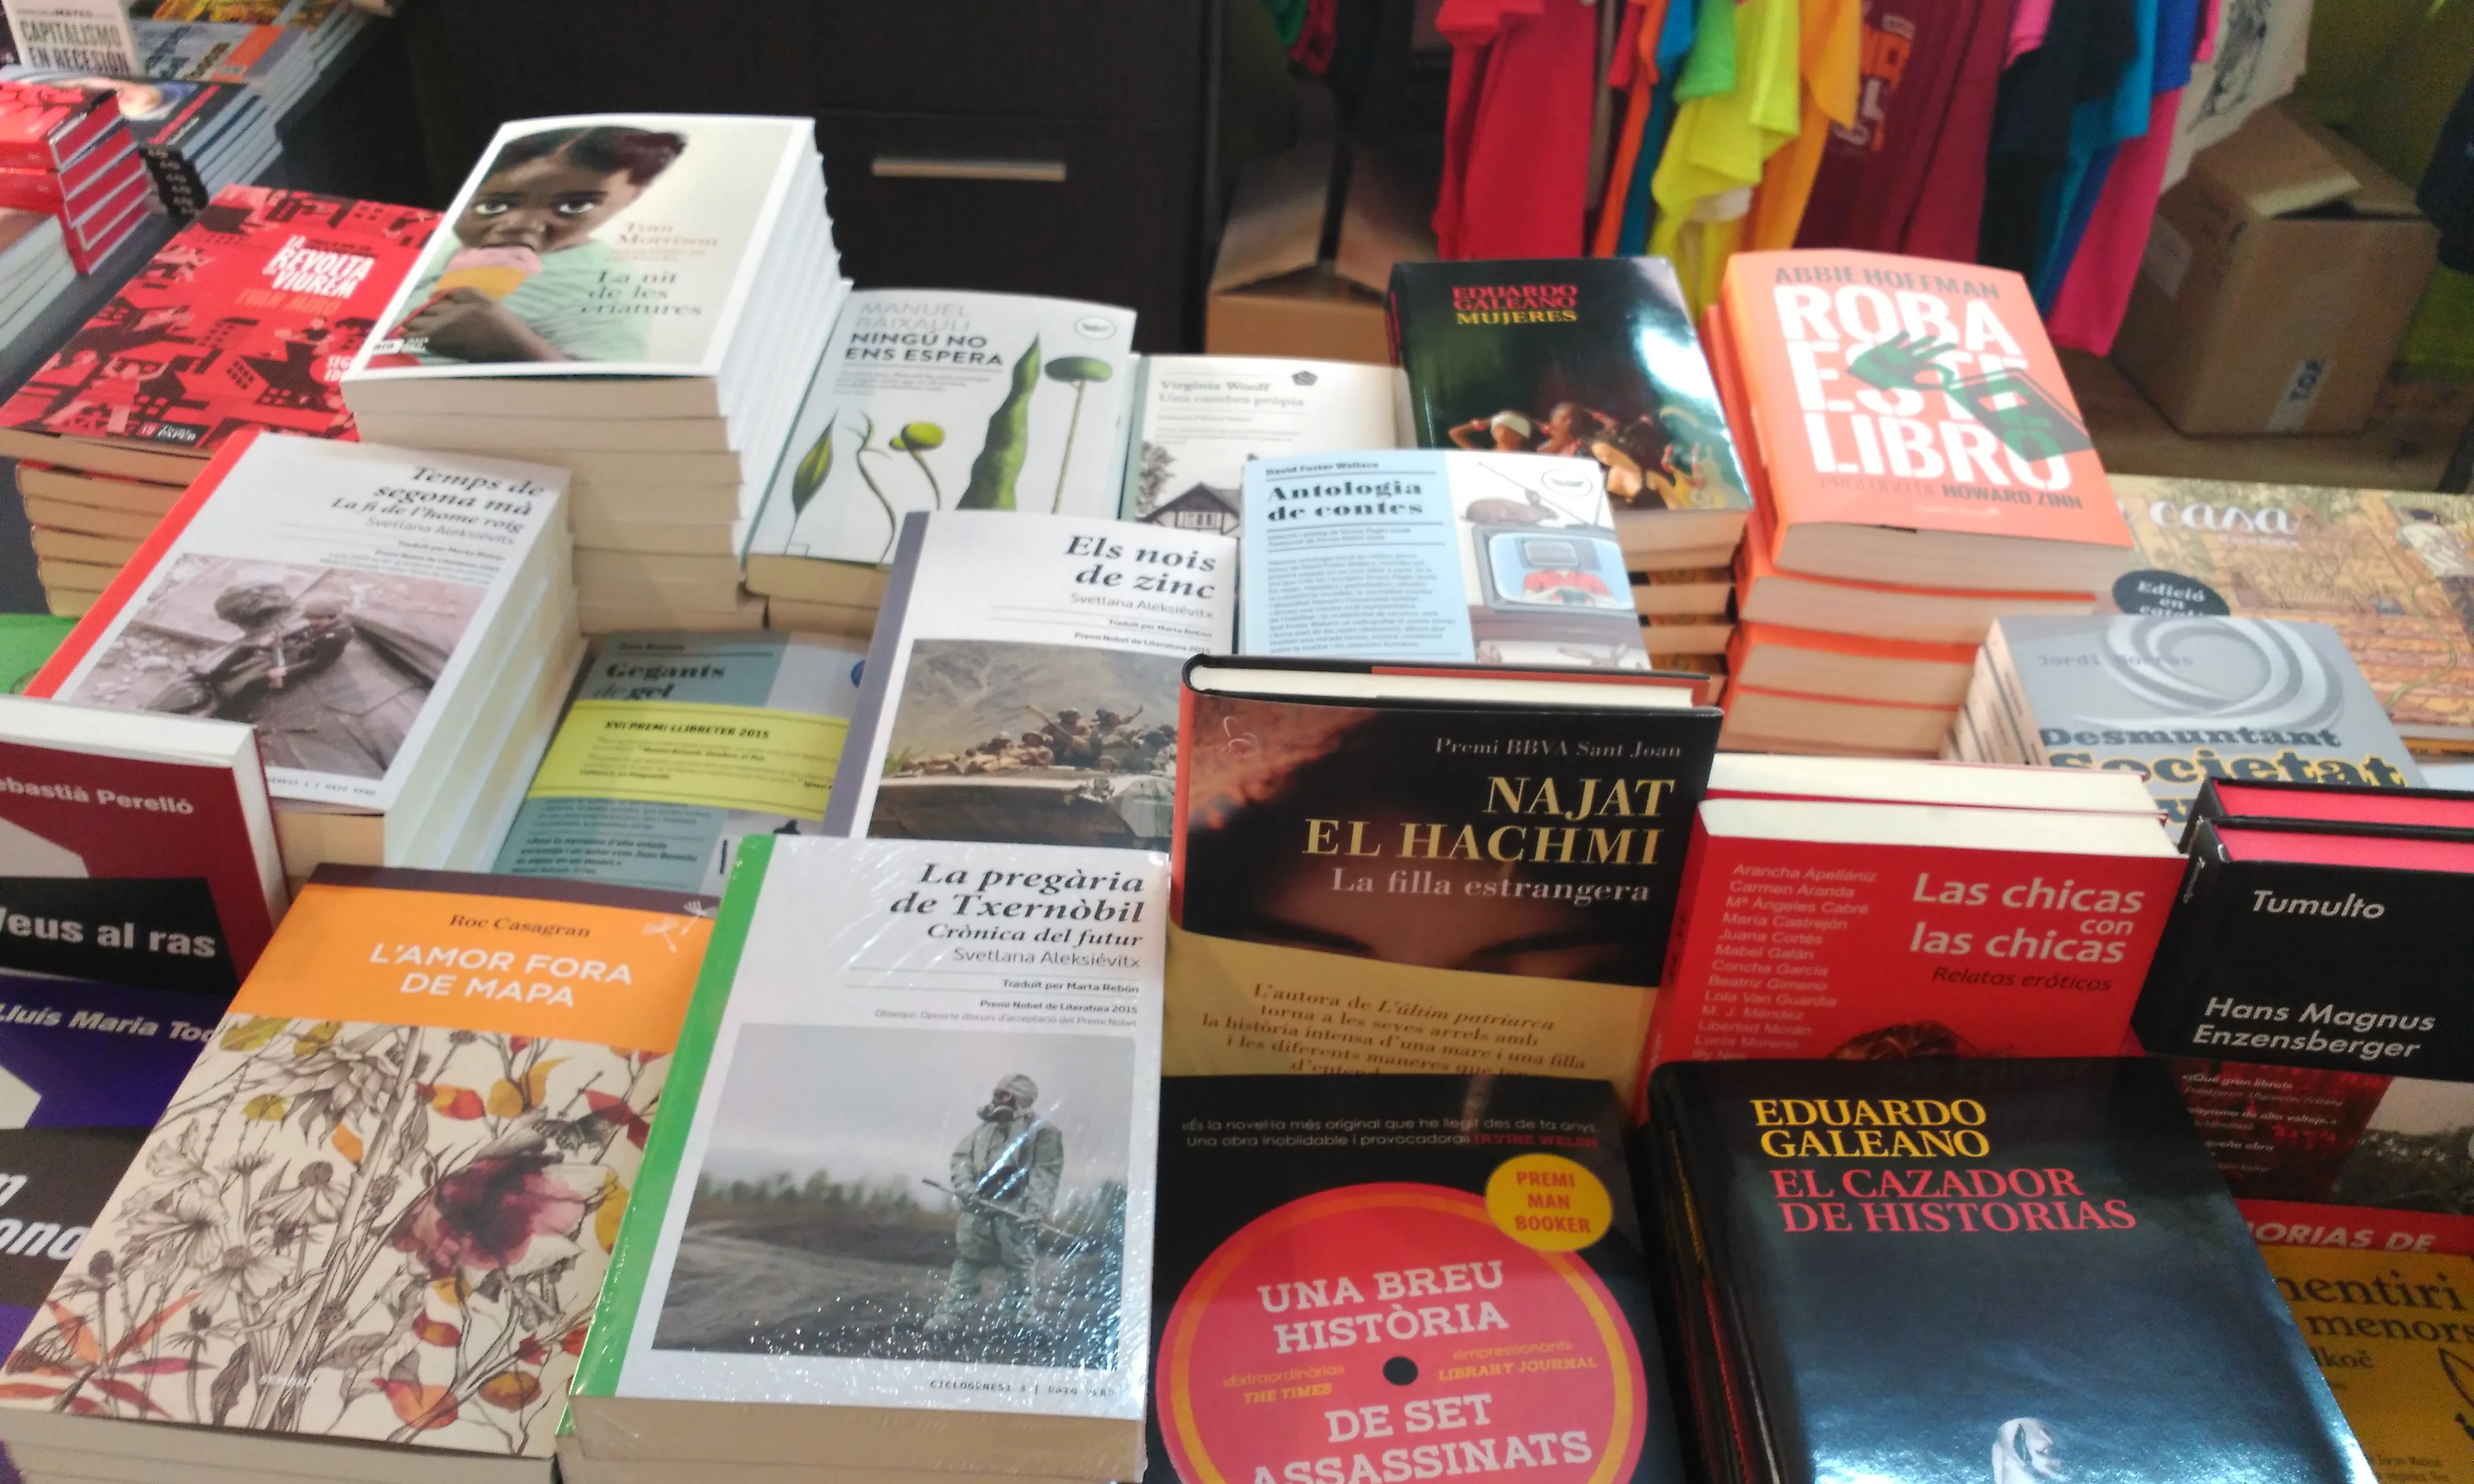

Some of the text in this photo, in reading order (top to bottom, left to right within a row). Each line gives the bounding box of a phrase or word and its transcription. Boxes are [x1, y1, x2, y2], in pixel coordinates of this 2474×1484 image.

[19, 19, 121, 47] CAPITALISMO
[28, 46, 51, 68] EN
[268, 247, 376, 281] REVOLTA
[272, 269, 359, 299] VIUREM
[1452, 285, 1578, 299] EDUARDO
[1775, 266, 2001, 300] ABBIE HOFFMAN
[580, 302, 702, 315] criatures
[861, 301, 970, 317] MANUEL
[1453, 296, 1577, 311] GALEANO
[856, 317, 971, 332] BAIXAULI
[1456, 309, 1578, 325] MUJERES
[1773, 285, 2021, 356] ROBA
[850, 331, 988, 348] NINGÚ NO
[844, 348, 1003, 366] ENS ESPERA
[1160, 381, 1221, 394] Virginia
[1787, 339, 2051, 429] ESTE
[1159, 394, 1191, 403] Una
[1194, 394, 1250, 405] cambra
[1804, 412, 2071, 491] LIBRO
[1266, 460, 1379, 476] David Foster Wallace
[412, 467, 545, 498] Temps de
[1267, 480, 1423, 502] Antologia
[373, 485, 532, 516] segona mà
[1942, 484, 2084, 510] HOWARD ZINN
[331, 497, 358, 510] La
[357, 500, 377, 513] fi
[380, 502, 407, 515] de
[484, 515, 525, 534] roig
[1267, 501, 1423, 523] de contes
[2149, 500, 2300, 535] casa
[365, 517, 432, 535] Svetlana
[1063, 535, 1217, 573] Els nois
[1075, 564, 1216, 600] de zinc
[2137, 581, 2206, 602] Edició
[1070, 593, 1214, 621] Svetlana Aleksiévitx
[2159, 597, 2185, 610] en
[605, 663, 726, 680] Gegants
[594, 683, 675, 700] de gel
[629, 722, 668, 732] PREMI
[671, 724, 735, 736] LLIBRETER
[739, 727, 771, 738] 2015
[2039, 727, 2341, 747] Desmuntant
[1435, 737, 1682, 759] Premi BBVA Sant Joan
[96, 789, 194, 815] Perelló
[1483, 776, 1675, 820] NAJAT
[1302, 819, 1665, 865] EL HACHMI
[916, 863, 1145, 894] La pregària
[1331, 867, 1650, 907] La filla estrangera
[1729, 881, 1855, 897] Carmen Aranda
[1913, 873, 2145, 914] Las chicas
[2253, 890, 2385, 919] Tumulto
[890, 892, 1145, 922] de Txernòbil
[450, 914, 590, 939] Roc Casagran
[927, 924, 1144, 948] Crònica del futur
[1718, 929, 1767, 942] Juana
[2079, 917, 2134, 936] con
[97, 922, 216, 958] al ras
[1909, 923, 2125, 965] las chicas
[524, 954, 632, 985] FORA
[953, 948, 1141, 969] Svetlana Aleksiévitx
[400, 973, 574, 1007] DE MAPA
[1045, 982, 1065, 992] per
[1066, 982, 1100, 992] Marta
[1932, 966, 2112, 993] Relatos eróticos
[980, 999, 1138, 1014] Premi Nobel de Literatura 2015
[1348, 996, 1371, 1010] de
[1453, 1013, 1555, 1031] patriarca
[2203, 996, 2437, 1032] Hans Magnus
[68, 1011, 159, 1036] Maria
[2192, 1024, 2422, 1061] Enzensberger
[1325, 1119, 1380, 1132] original
[1751, 1099, 1987, 1127] EDUARDO
[1760, 1130, 1991, 1158] GALEANO
[1516, 1171, 1575, 1189] PREMI
[1770, 1167, 2084, 1199] EL CAZADOR
[1527, 1193, 1571, 1211] MAN
[1515, 1214, 1592, 1235] BOOKER
[1784, 1199, 2137, 1233] DE HISTORIAS
[2384, 1231, 2437, 1252] DE
[1257, 1259, 1505, 1313] UNA BREU
[1273, 1300, 1509, 1354] HISTÒRIA
[1438, 1356, 1597, 1382] LIBRARY JOURNAL
[1243, 1382, 1333, 1404] THE TIMES
[1324, 1393, 1492, 1443] DE SET
[1251, 1430, 1594, 1484] ASSASSINATS
